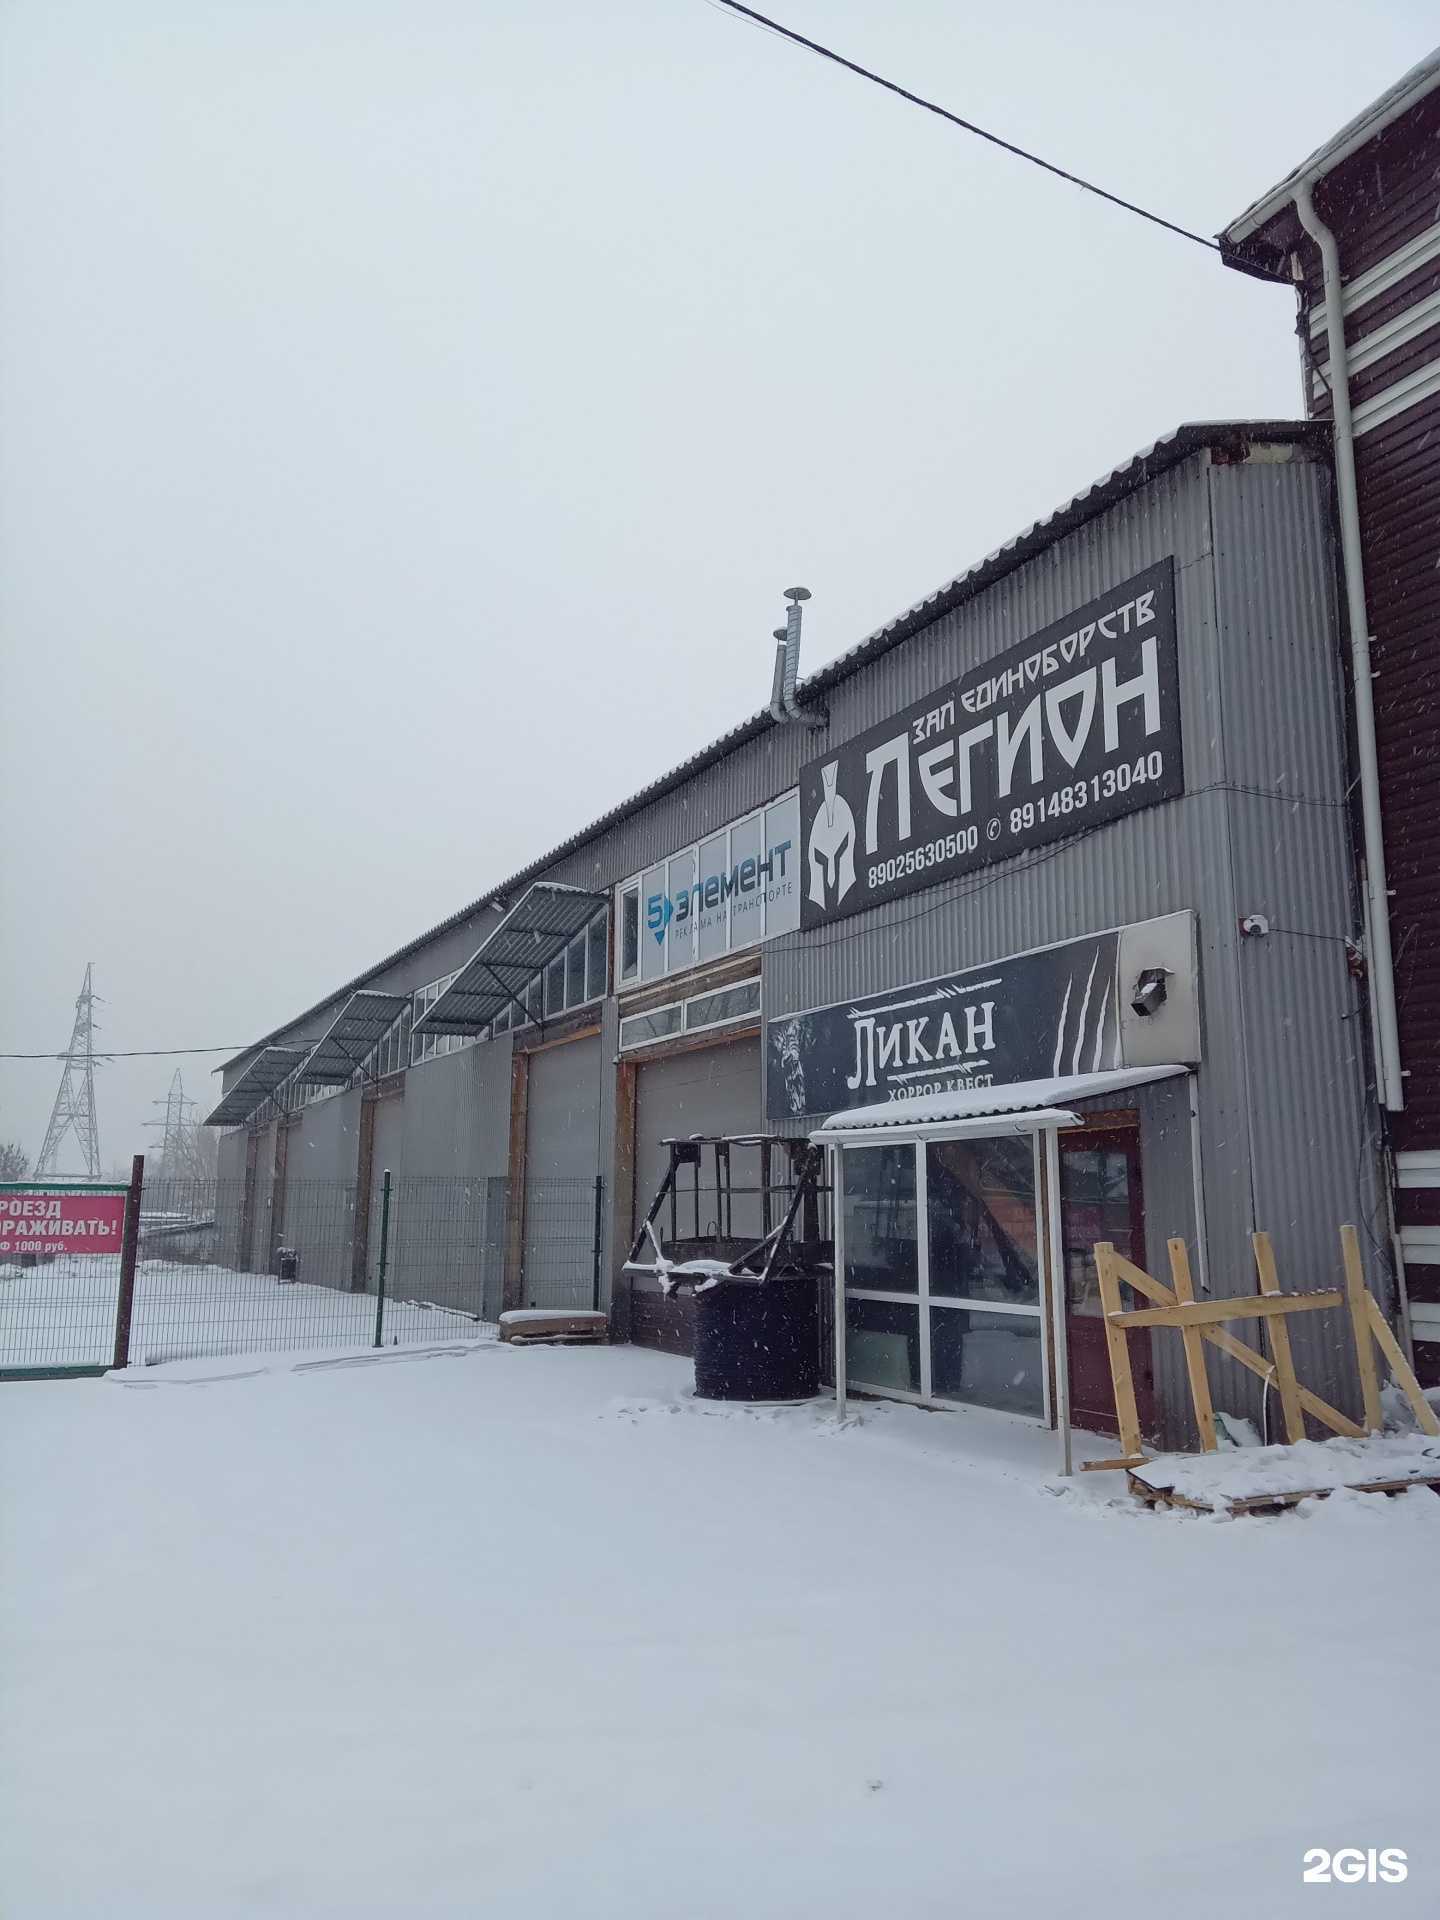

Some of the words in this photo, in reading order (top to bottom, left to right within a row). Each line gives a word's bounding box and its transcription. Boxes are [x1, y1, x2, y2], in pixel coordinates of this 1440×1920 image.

[961, 589, 1156, 713] ЕДИНОБОРСТВ
[864, 635, 1162, 855] ЛЕГИОН
[867, 824, 979, 889] 89025630500
[1009, 750, 1164, 834] 89148313040
[846, 1001, 996, 1090] ЛИКАН
[887, 1081, 942, 1103] ХОРРОР
[946, 1073, 994, 1093] КВЕСТ
[0, 1219, 117, 1236] РАЖИВАТЬ!
[15, 1240, 42, 1251] 1000
